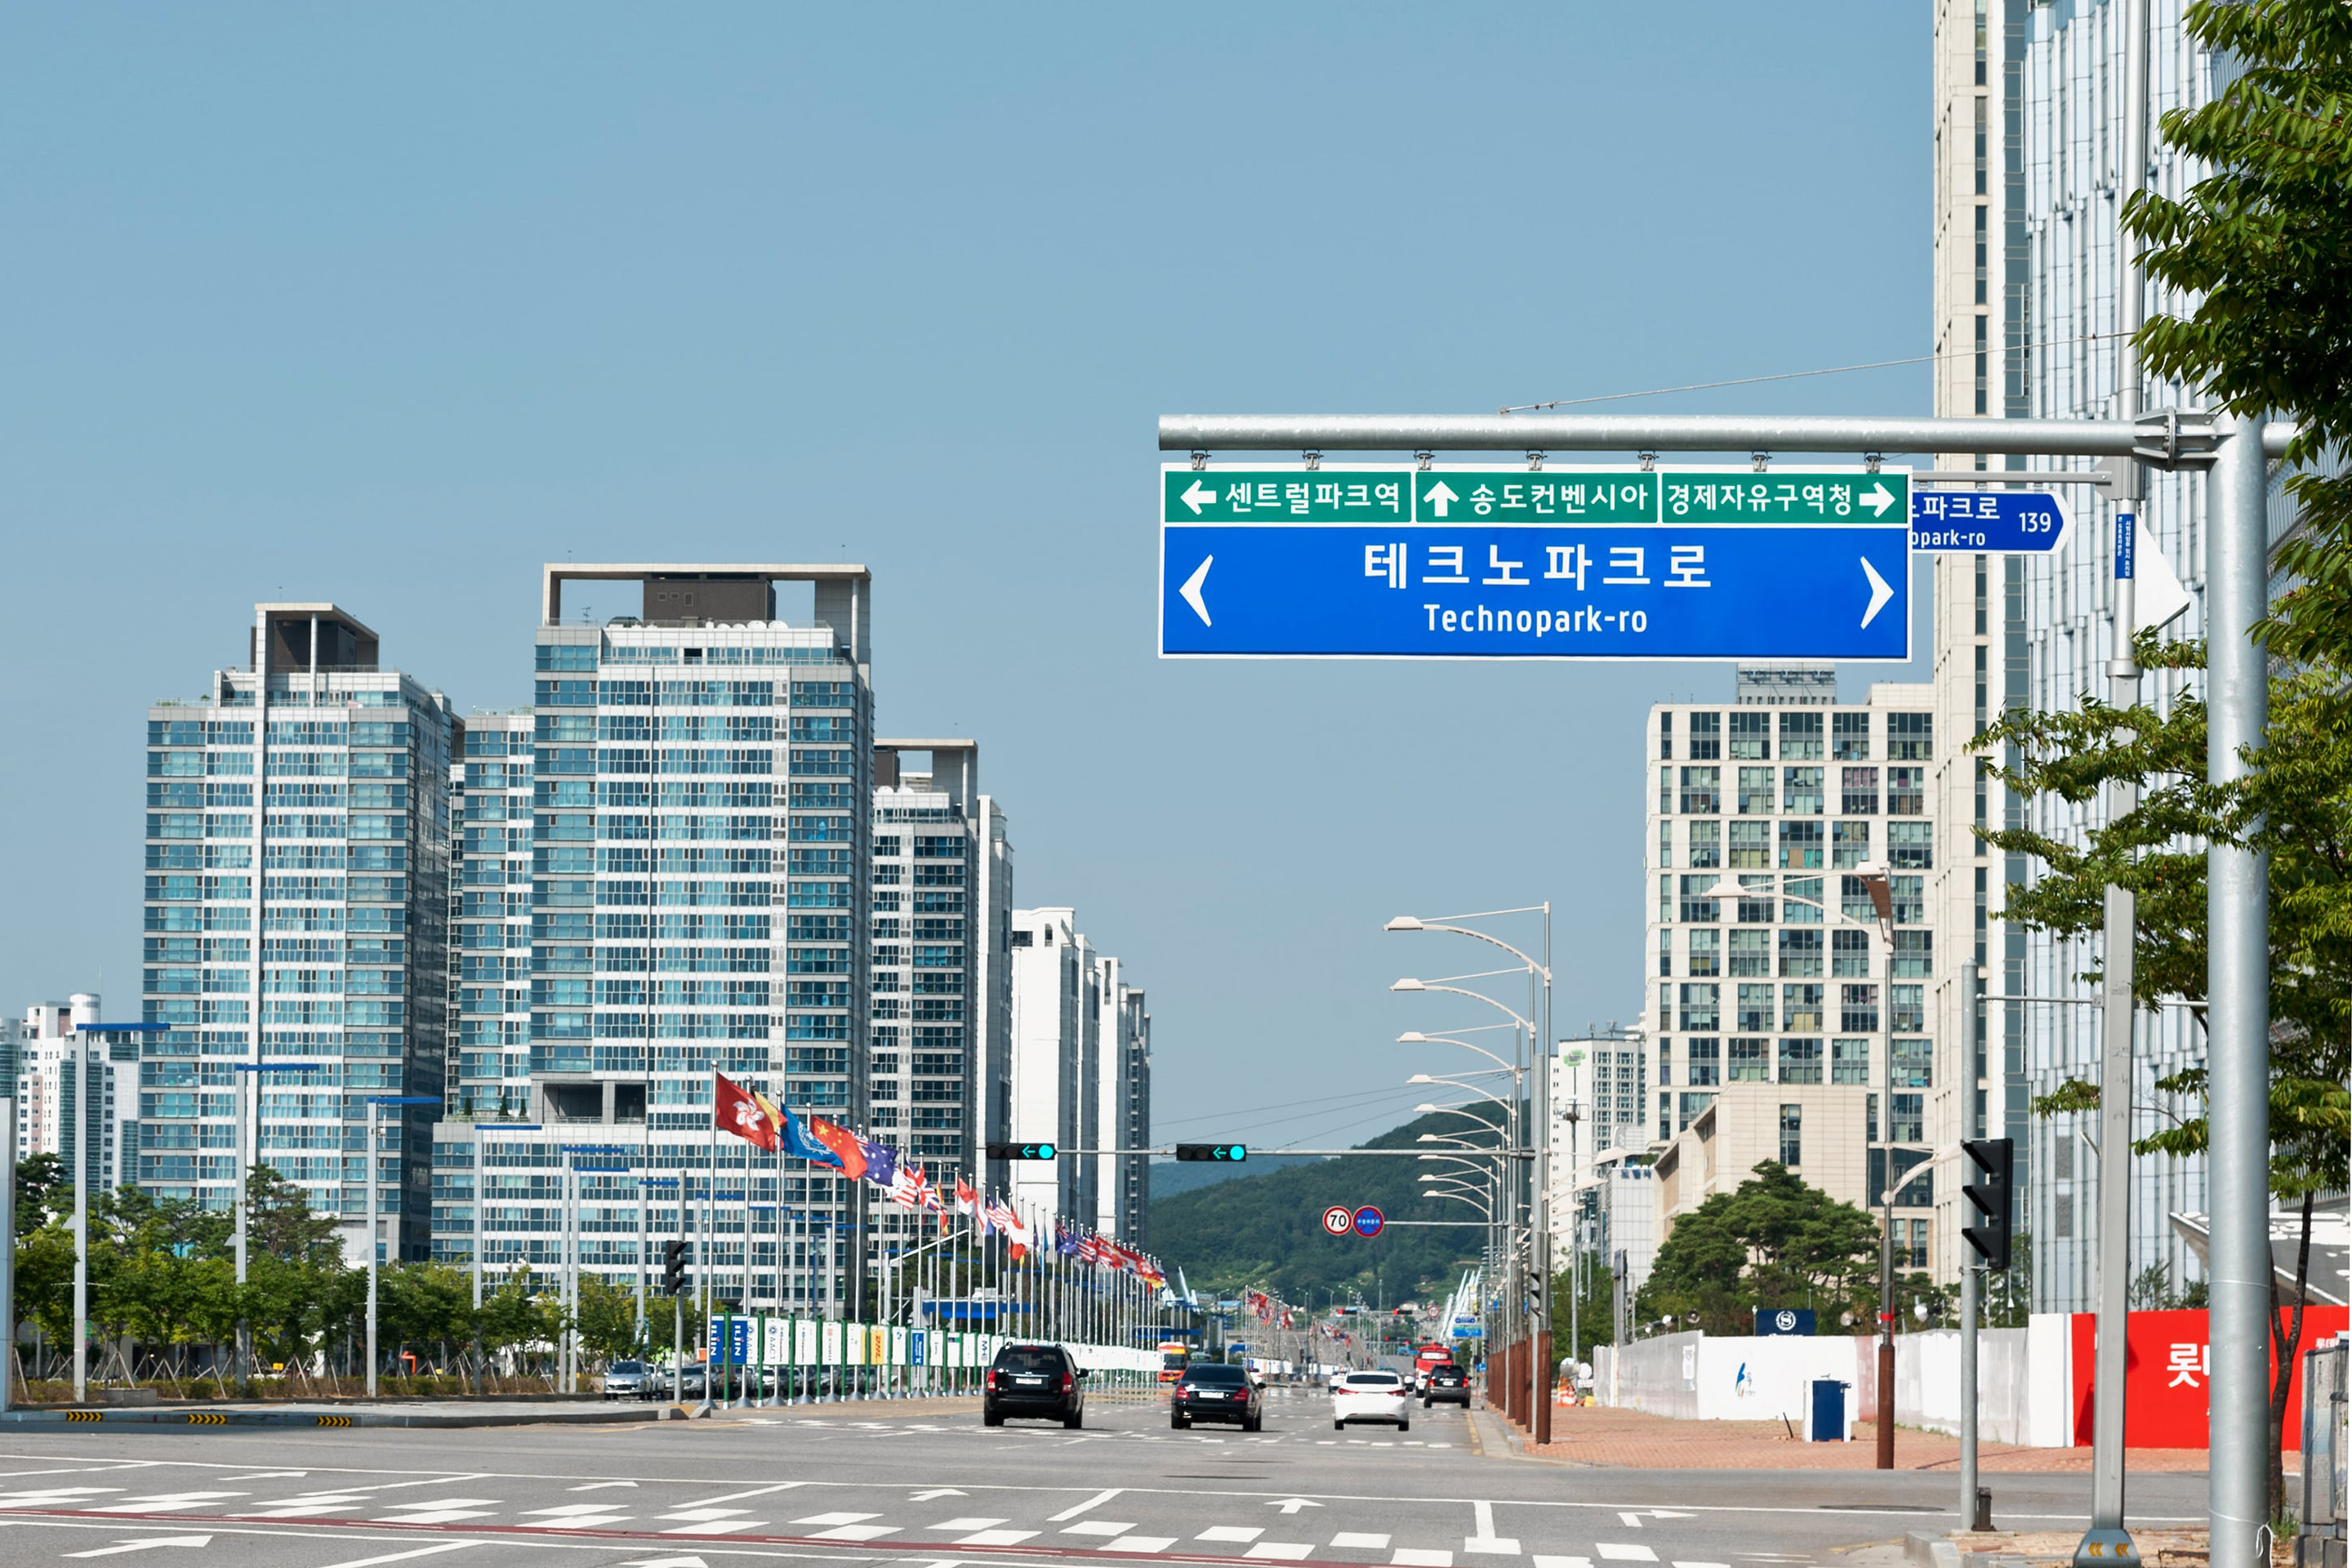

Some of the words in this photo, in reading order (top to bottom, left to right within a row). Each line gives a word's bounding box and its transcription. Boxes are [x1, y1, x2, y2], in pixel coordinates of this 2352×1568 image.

[1225, 483, 1399, 514] 센트럴파크역
[1469, 483, 1649, 515] 송도컨벤시아
[1668, 483, 1851, 516] 경제자유구역청
[2019, 512, 2051, 532] 139
[1365, 542, 1712, 591] 테크노파크로
[1423, 604, 1648, 638] Technopark-ro
[1330, 1214, 1347, 1227] 70
[733, 1325, 742, 1356] ILJIN
